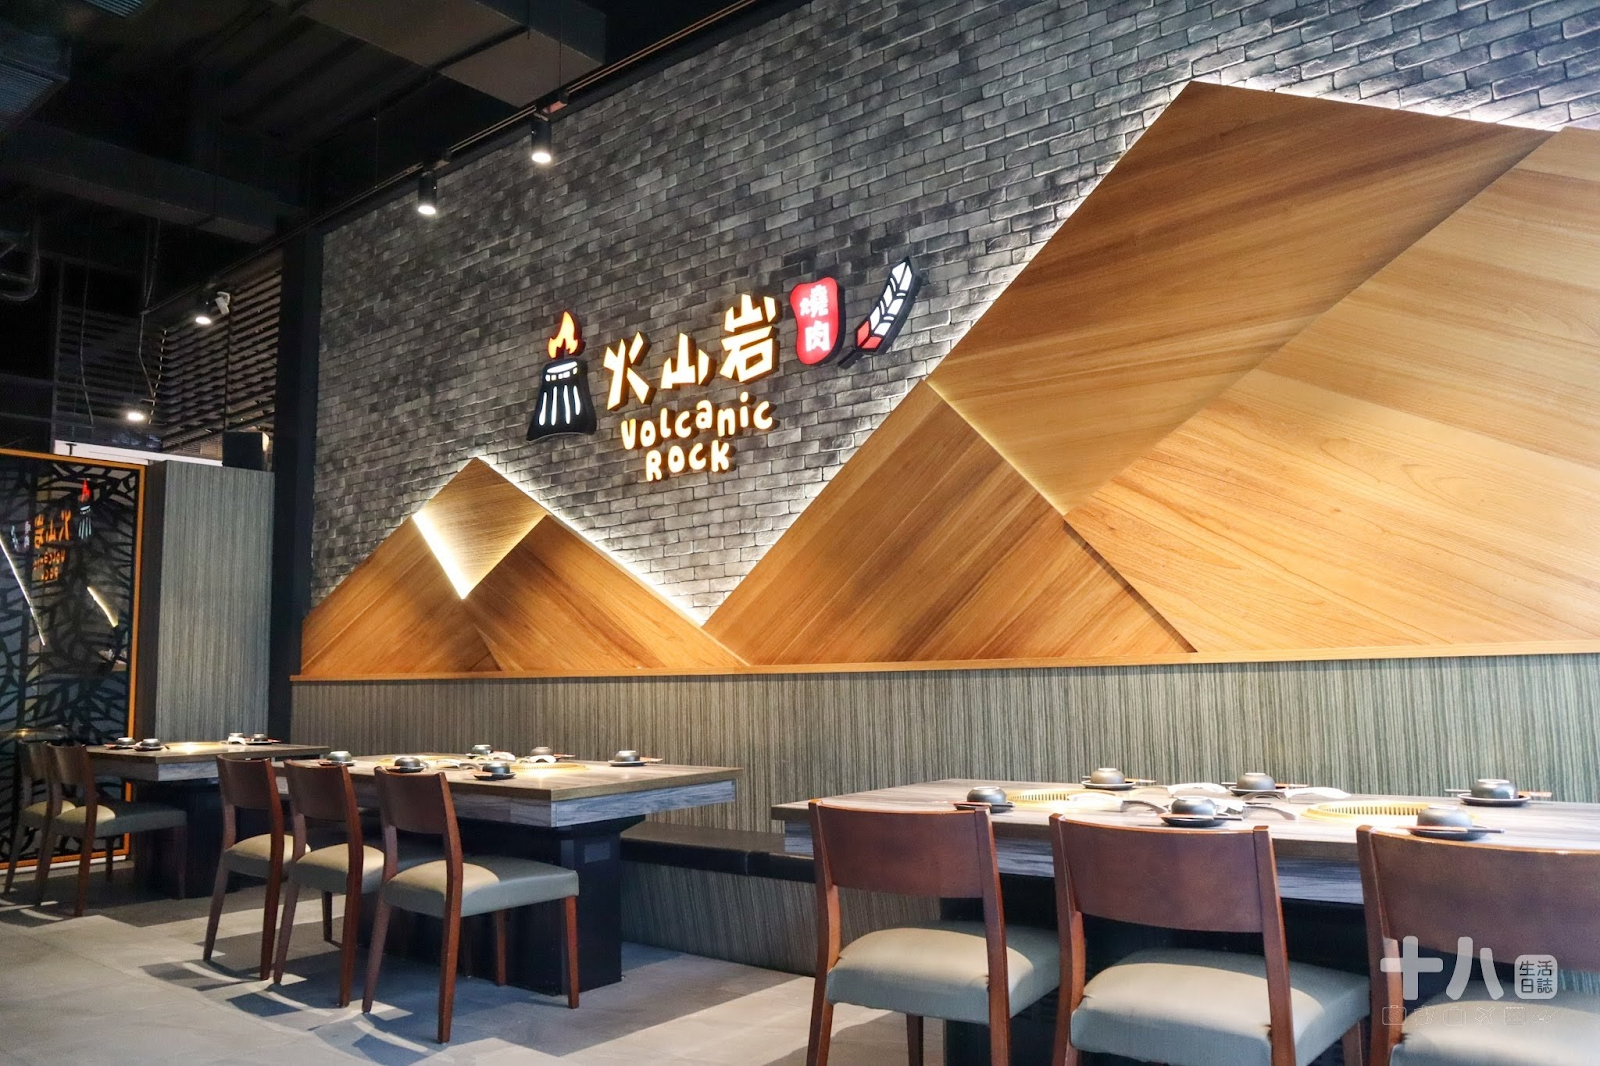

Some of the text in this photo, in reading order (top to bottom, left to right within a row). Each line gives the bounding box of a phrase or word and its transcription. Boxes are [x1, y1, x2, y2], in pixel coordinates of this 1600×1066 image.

[799, 284, 830, 352] 燒肉
[603, 294, 778, 411] 火山岩
[646, 440, 730, 482] ROCK
